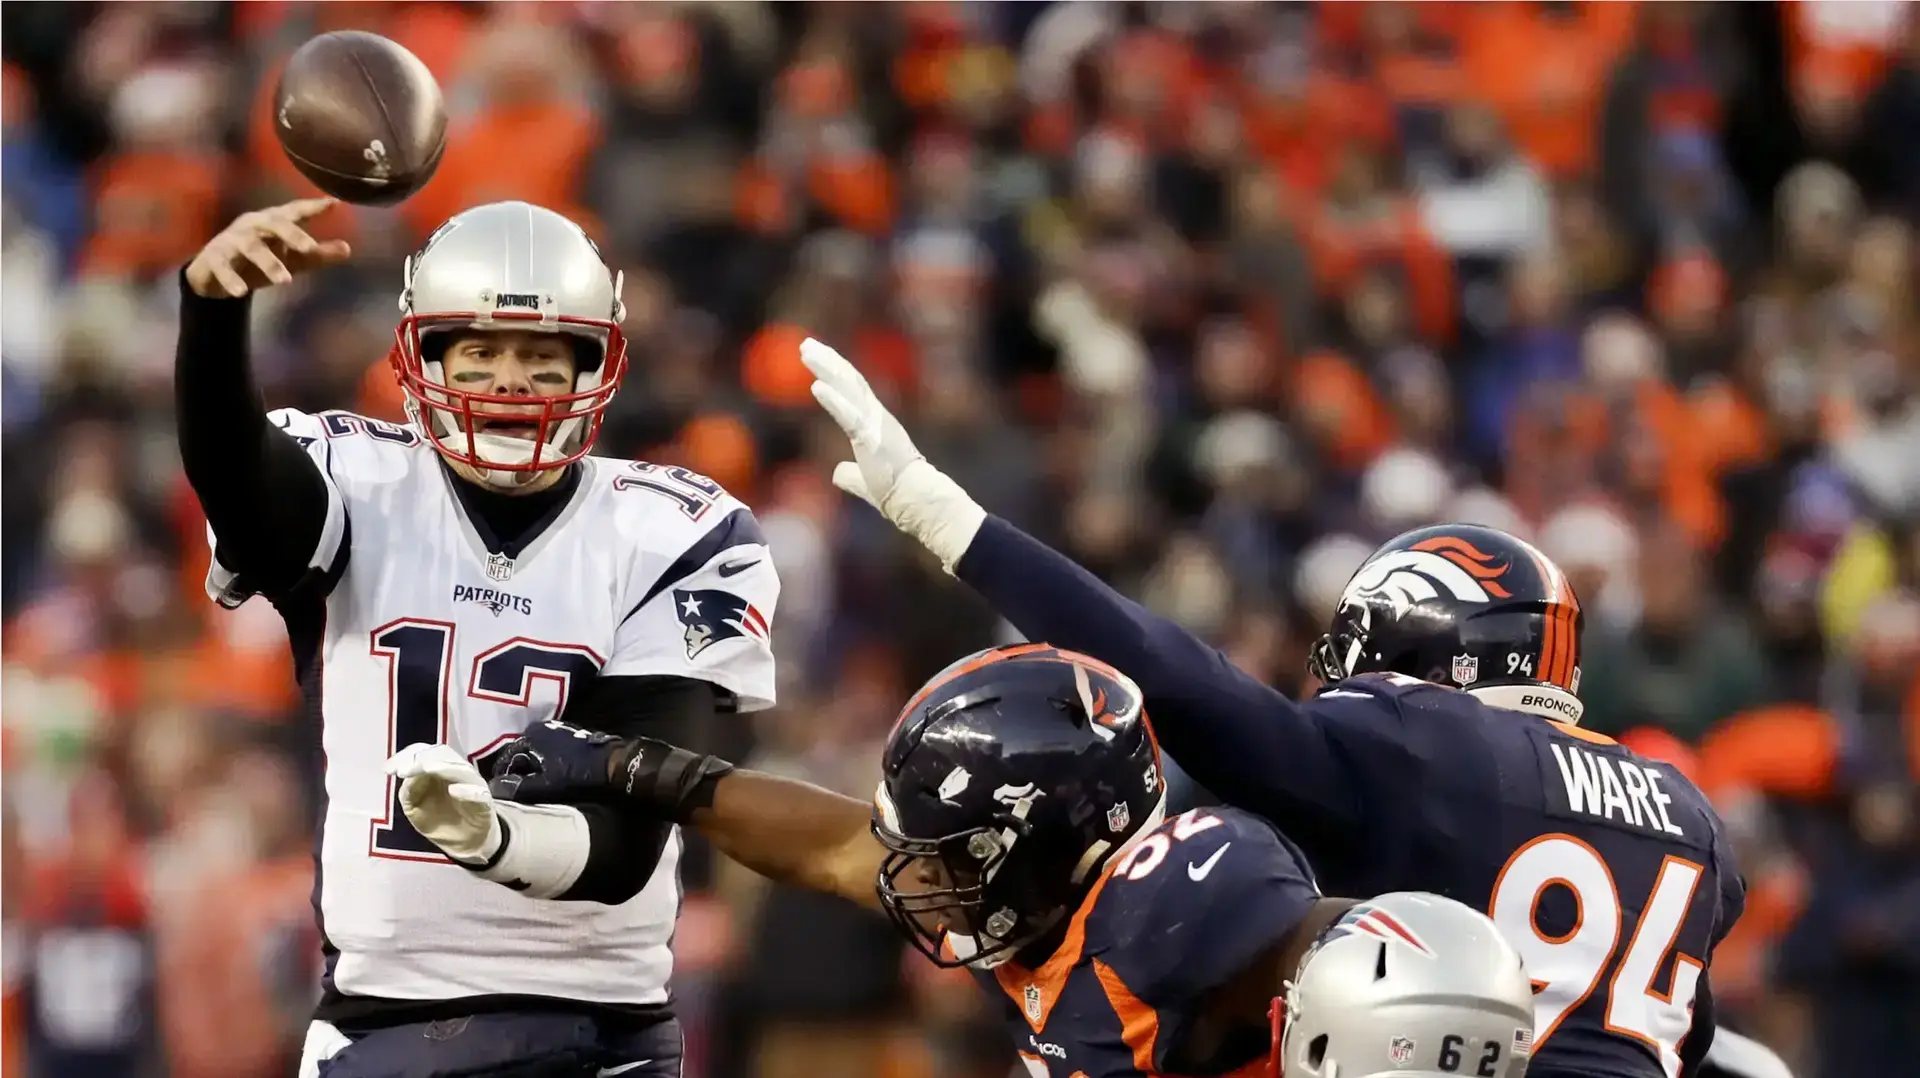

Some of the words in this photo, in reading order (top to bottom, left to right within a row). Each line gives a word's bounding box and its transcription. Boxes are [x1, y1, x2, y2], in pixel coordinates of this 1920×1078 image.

[496, 293, 539, 310] PATRIOTS
[613, 461, 728, 522] 12
[489, 564, 510, 579] NFL
[453, 584, 532, 615] PATRIOTS
[1456, 667, 1474, 679] NFL
[1506, 652, 1532, 677] 94
[1521, 695, 1579, 720] BRONCOS
[1144, 763, 1158, 793] 52
[1550, 743, 1683, 836] WARE
[1488, 832, 1703, 1078] 94
